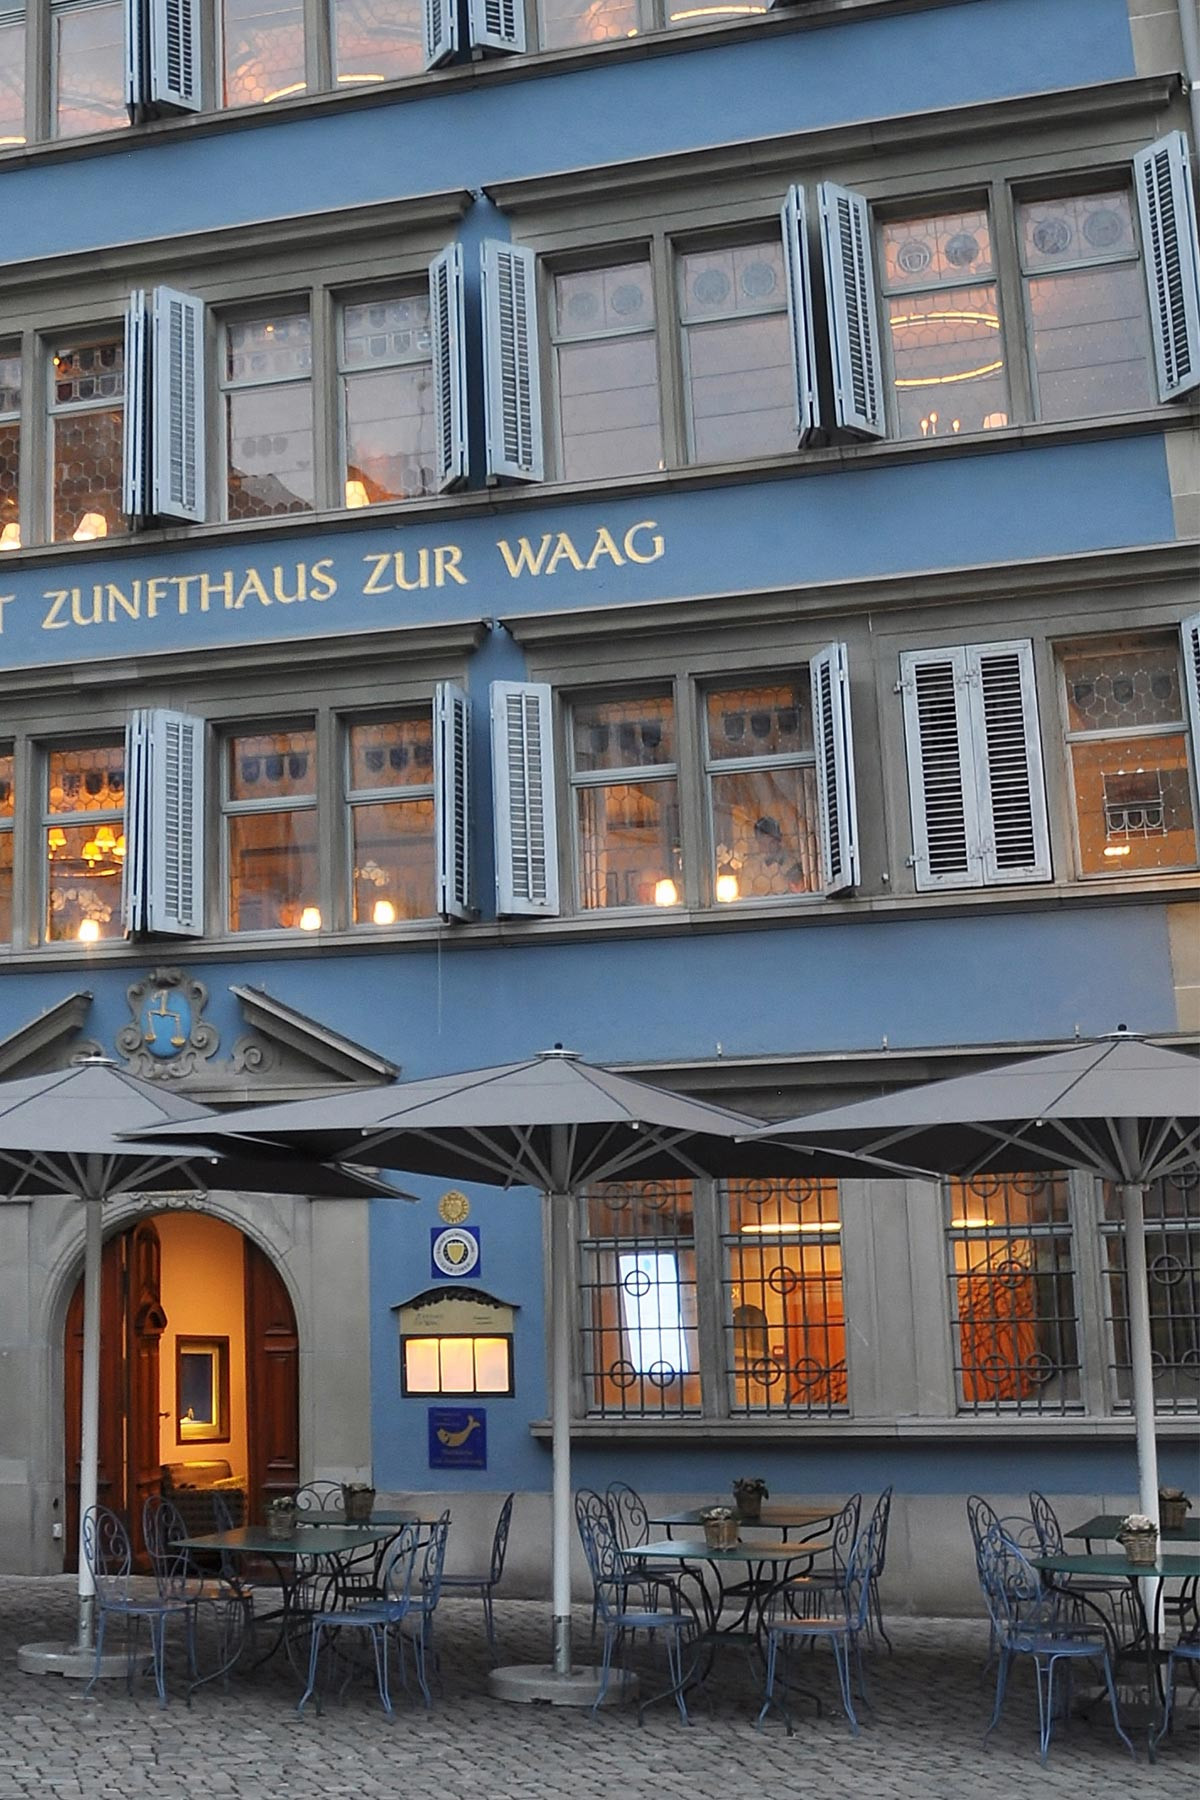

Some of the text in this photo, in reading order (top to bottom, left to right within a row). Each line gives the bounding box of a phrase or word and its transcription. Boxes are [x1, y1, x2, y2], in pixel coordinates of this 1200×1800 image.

[41, 558, 338, 631] ZUNFTHAUS
[362, 544, 469, 595] ZUR
[496, 520, 665, 579] WAAG
